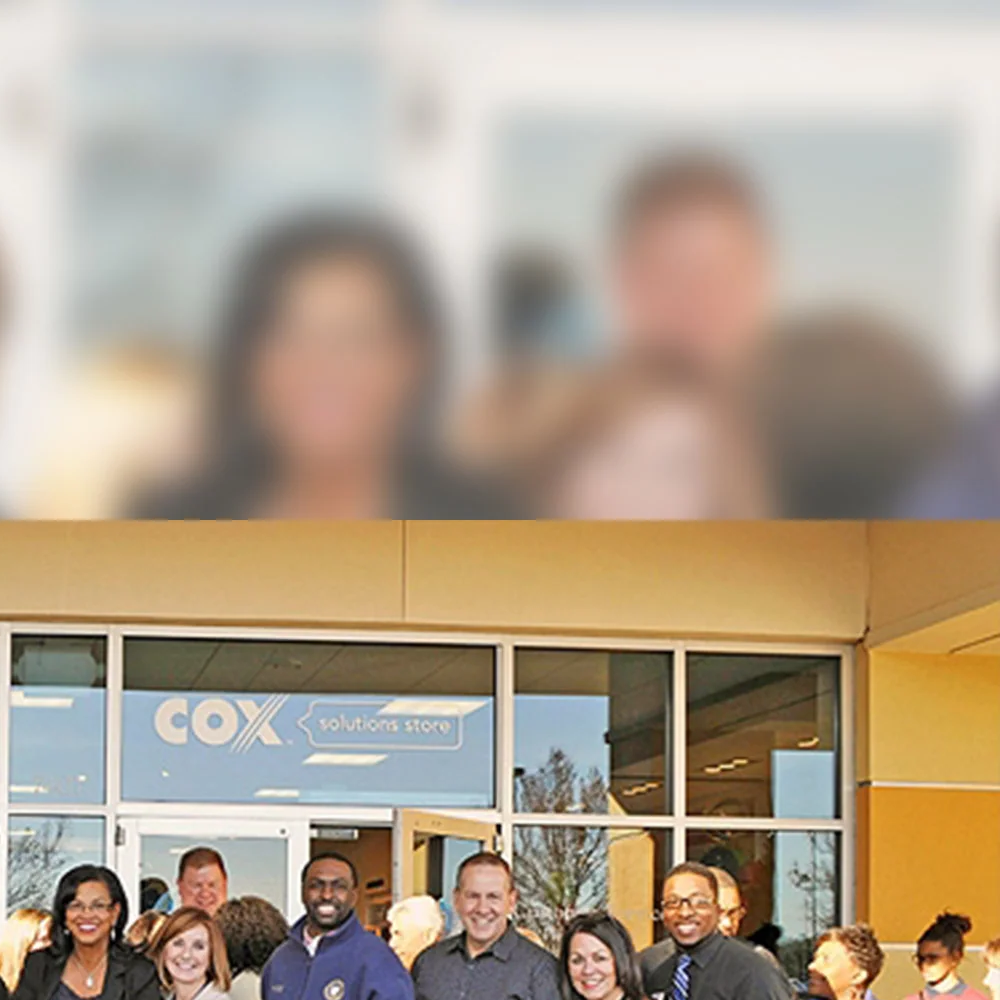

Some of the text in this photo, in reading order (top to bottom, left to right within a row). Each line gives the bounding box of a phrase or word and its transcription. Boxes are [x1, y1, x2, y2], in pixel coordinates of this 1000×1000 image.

[154, 693, 290, 753] COX
[318, 711, 451, 735] solutions store
